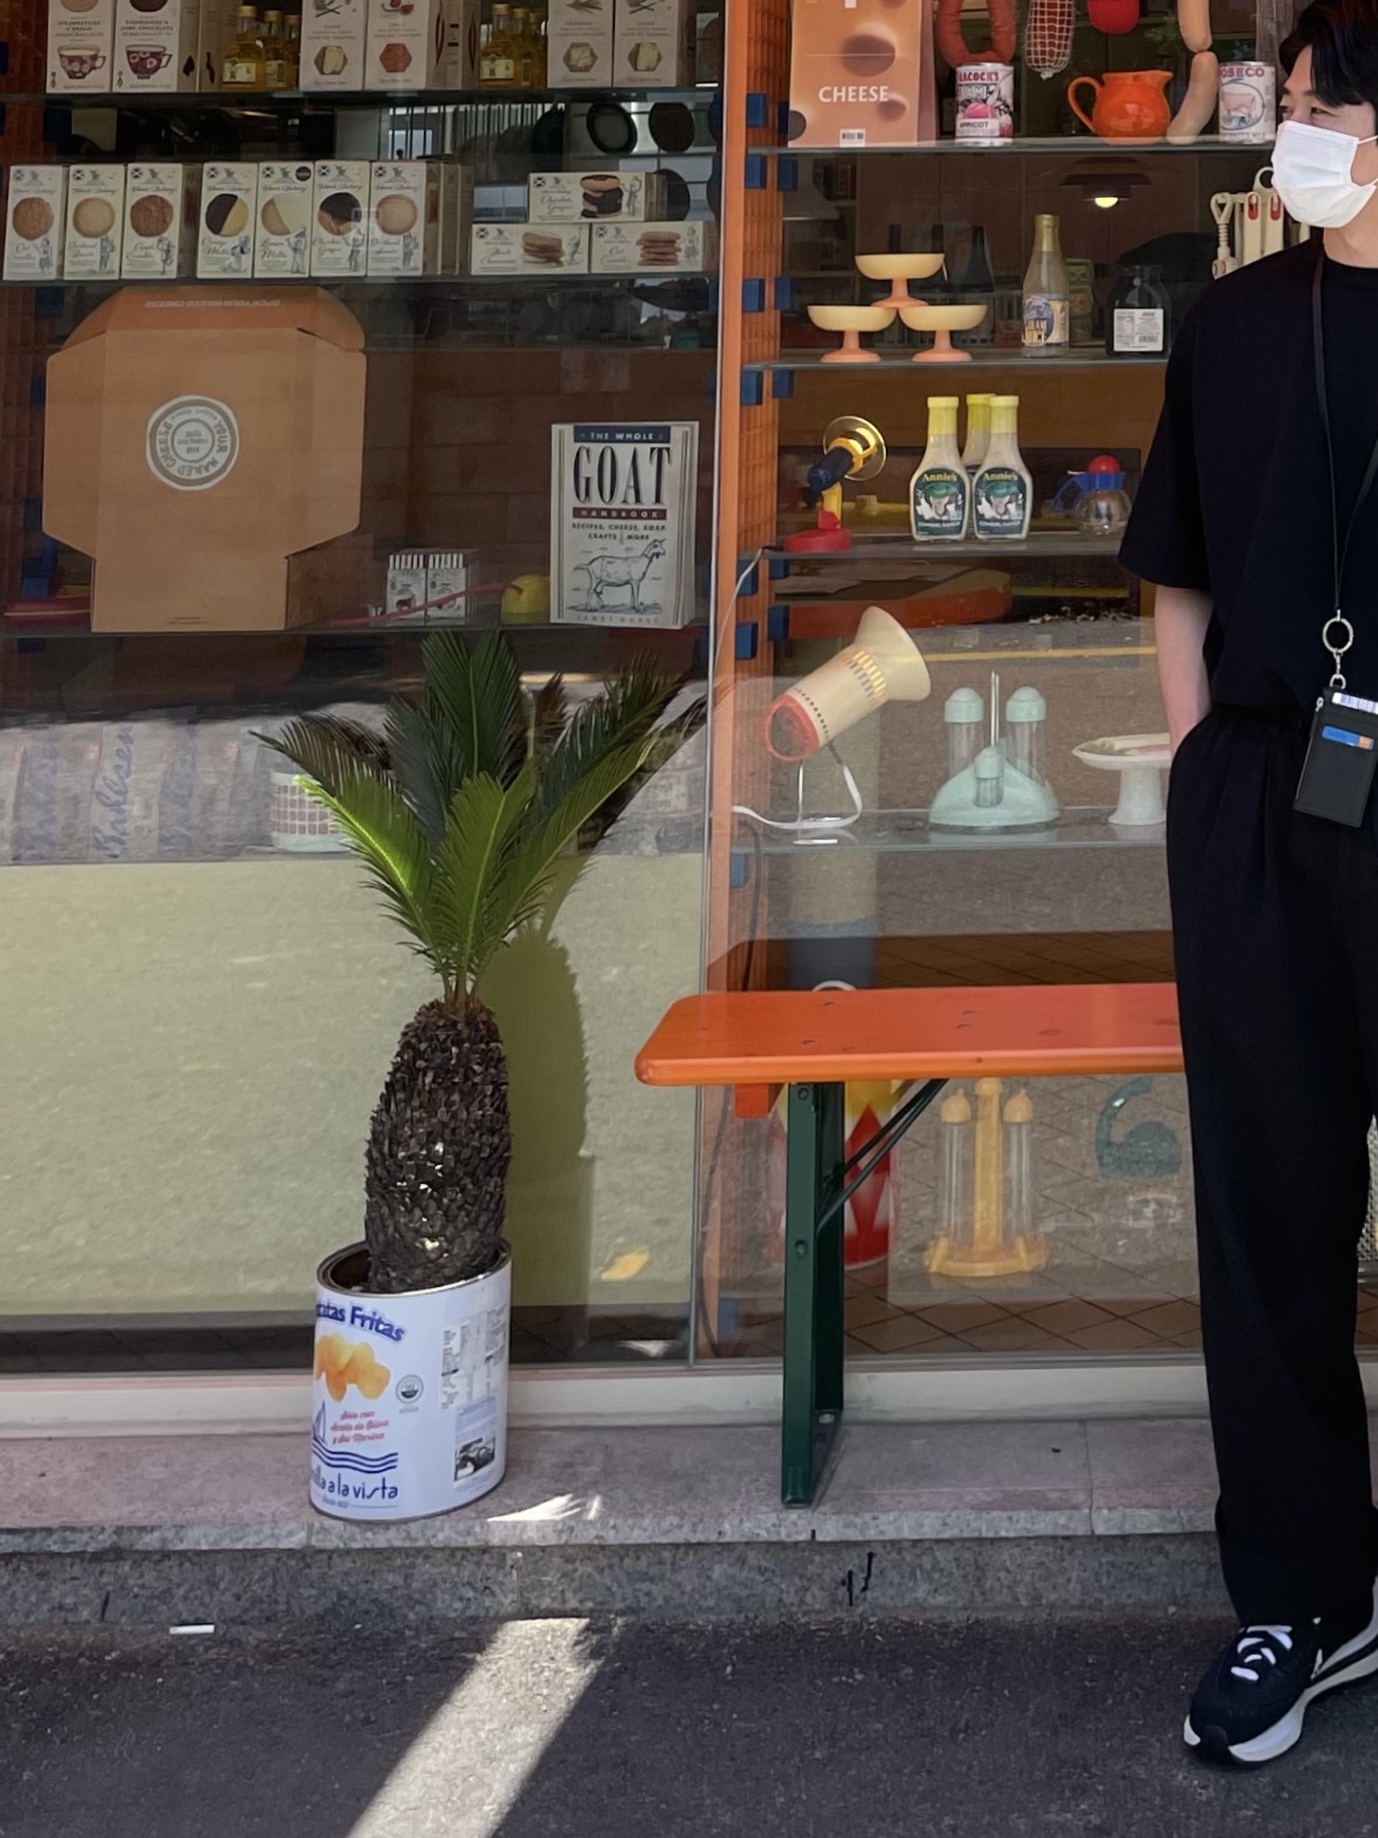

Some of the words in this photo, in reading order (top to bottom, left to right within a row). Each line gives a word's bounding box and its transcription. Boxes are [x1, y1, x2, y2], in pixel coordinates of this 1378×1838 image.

[818, 85, 890, 103] CHEESE
[590, 432, 610, 441] THE
[615, 432, 655, 441] WHOLE
[573, 445, 674, 506] GOAT
[922, 472, 958, 483] Annie's
[983, 471, 1019, 482] Annie's
[581, 509, 660, 519] HANDBOOK
[350, 1304, 406, 1343] Fritas
[328, 1480, 337, 1494] a
[337, 1473, 350, 1498] la
[352, 1476, 400, 1501] vista
